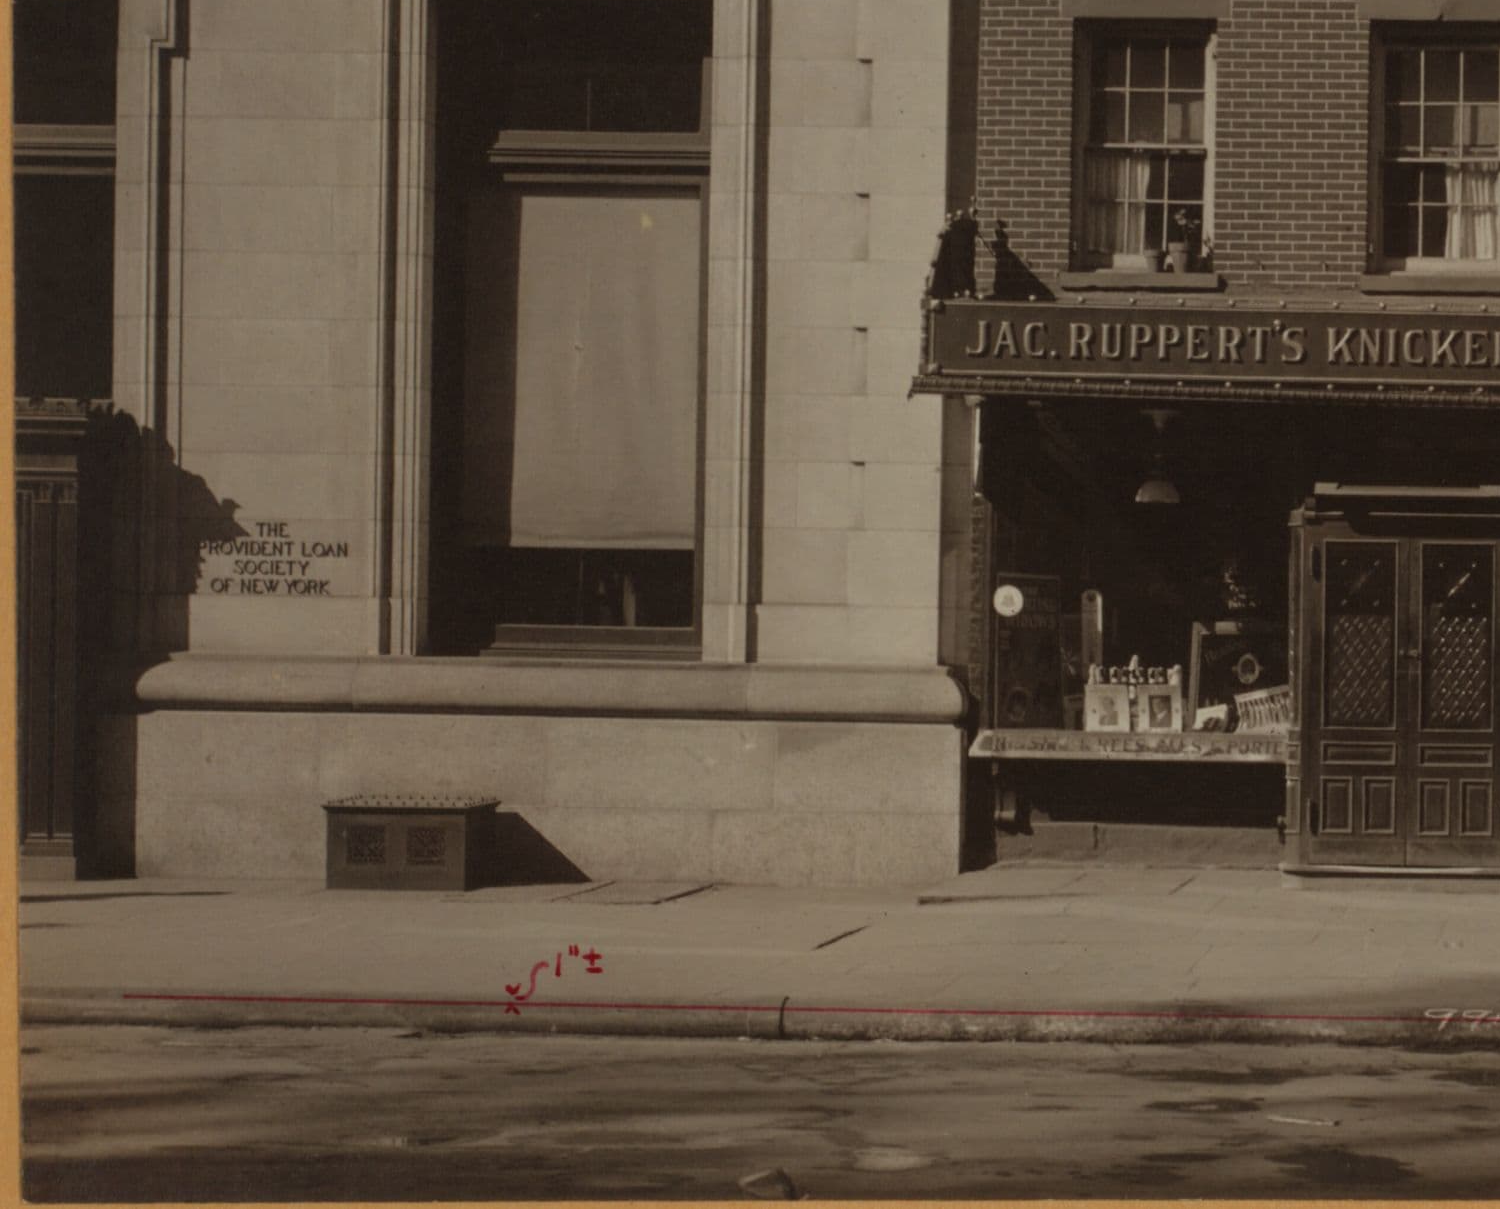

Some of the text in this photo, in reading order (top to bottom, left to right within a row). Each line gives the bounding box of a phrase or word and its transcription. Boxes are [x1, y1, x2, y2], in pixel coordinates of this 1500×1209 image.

[965, 320, 1058, 360] JAC.
[1070, 321, 1308, 365] RUPPERT'S
[256, 521, 291, 538] THE
[199, 540, 349, 558] PROVIDENT LOAN
[234, 559, 311, 576] SOCIETY
[210, 577, 331, 595] OF NEW YORK
